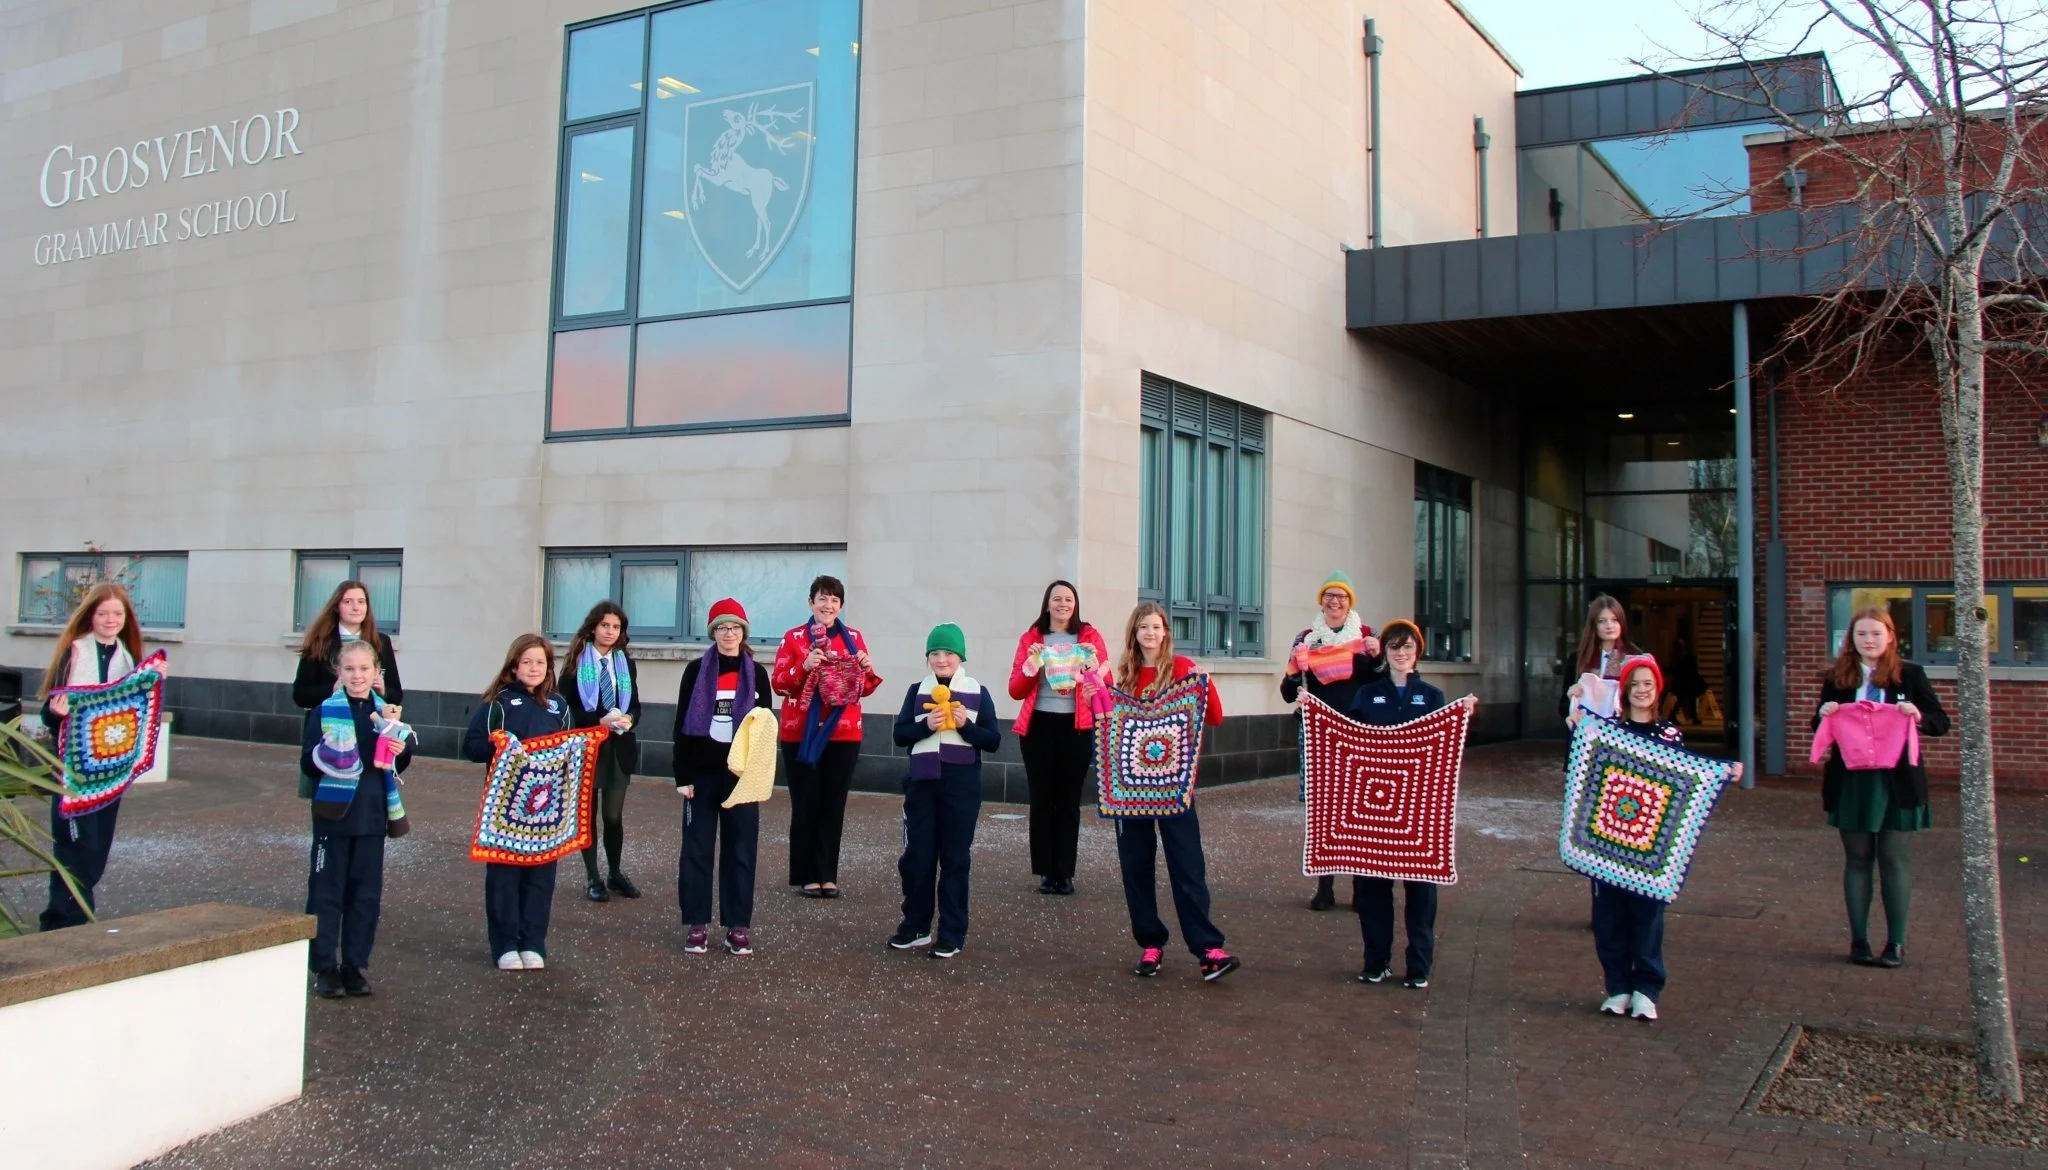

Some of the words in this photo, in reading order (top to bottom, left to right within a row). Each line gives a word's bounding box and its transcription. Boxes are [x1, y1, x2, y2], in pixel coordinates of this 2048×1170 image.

[40, 107, 303, 208] GROSVENOR
[34, 212, 169, 266] GRAMMAR
[176, 189, 296, 241] SCHOOL
